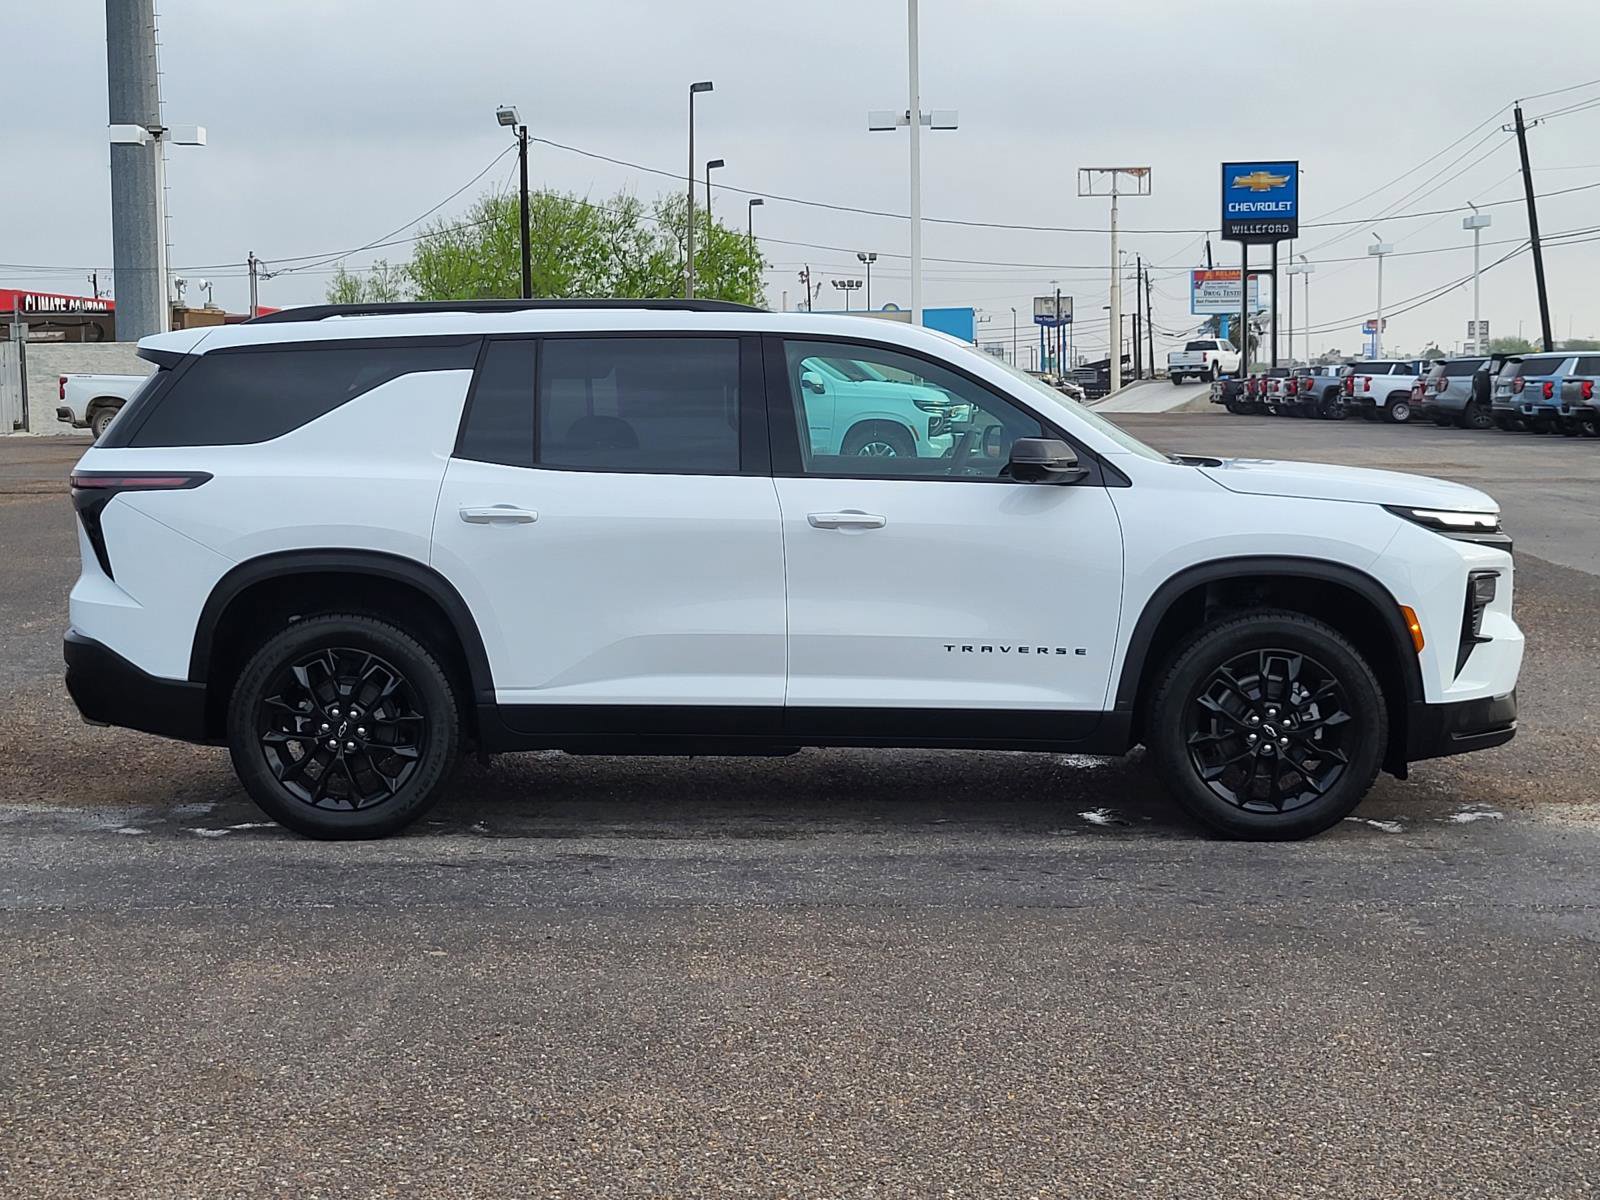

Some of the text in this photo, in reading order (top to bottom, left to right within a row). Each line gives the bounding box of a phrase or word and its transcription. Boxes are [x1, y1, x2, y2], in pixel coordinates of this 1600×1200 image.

[1228, 201, 1292, 212] CHEVROLET
[1231, 224, 1289, 234] WILLEFORD
[25, 294, 66, 311] CLIMATE
[944, 644, 1087, 656] TRAVERSE
